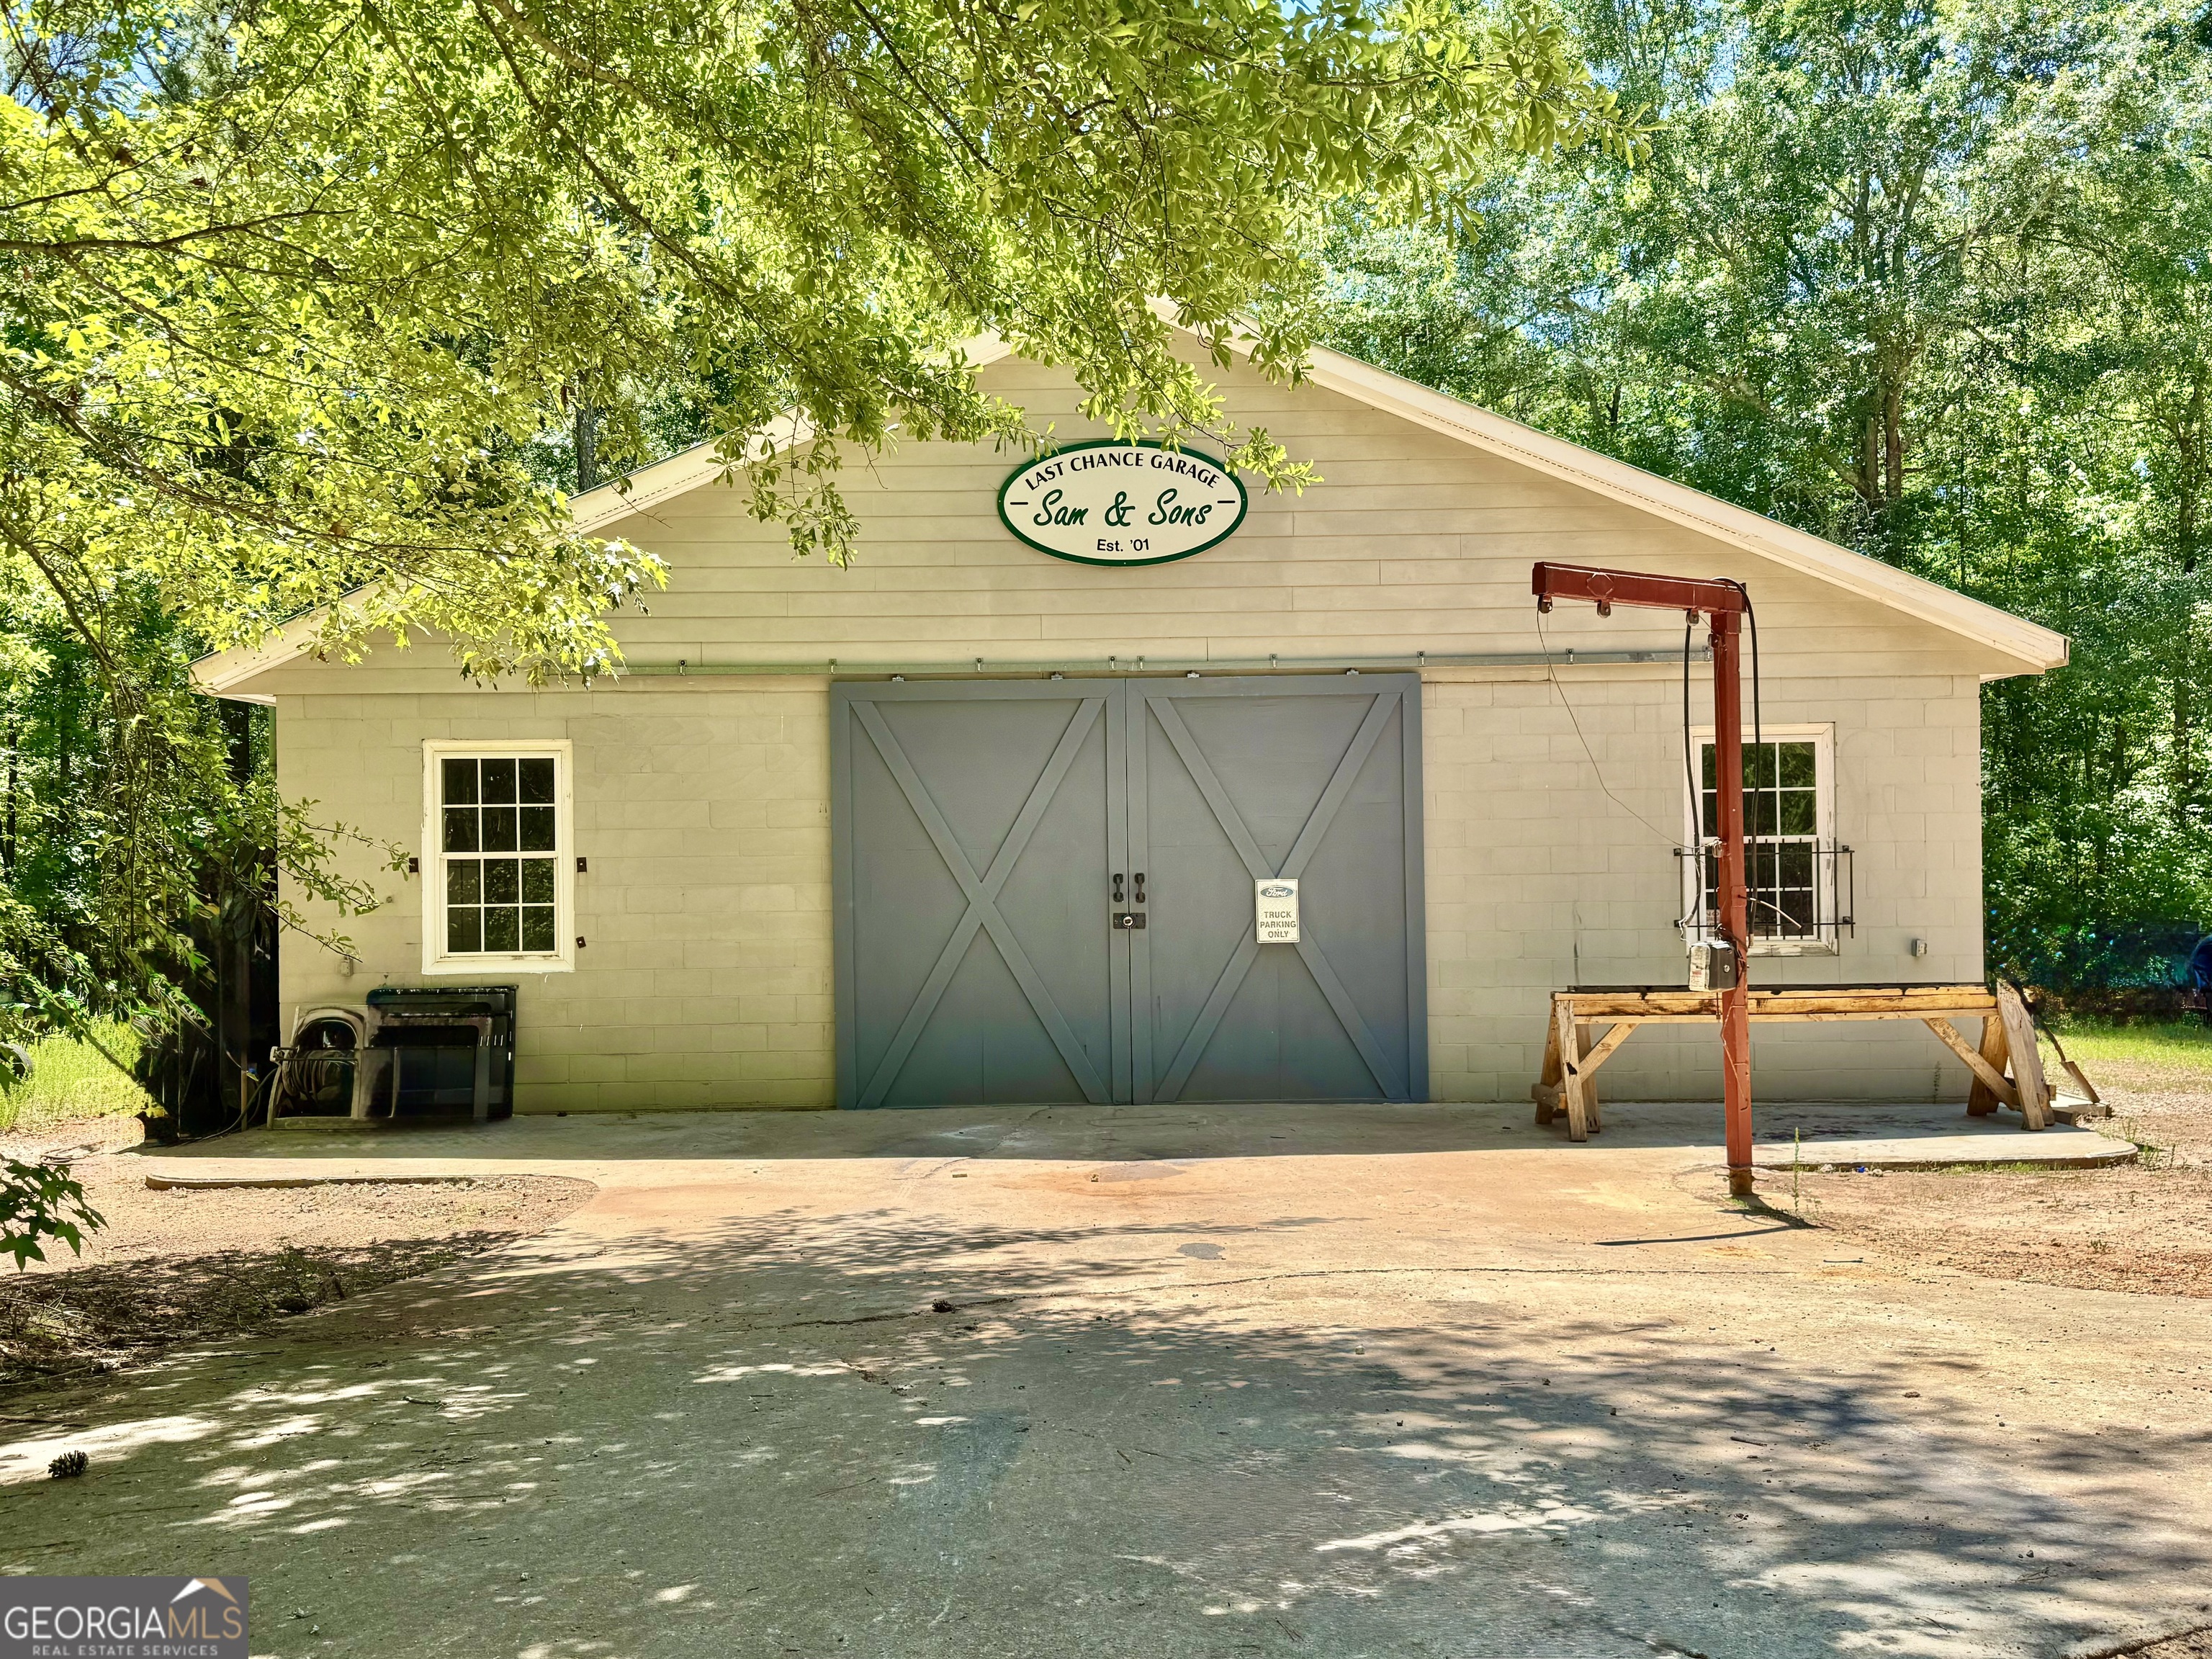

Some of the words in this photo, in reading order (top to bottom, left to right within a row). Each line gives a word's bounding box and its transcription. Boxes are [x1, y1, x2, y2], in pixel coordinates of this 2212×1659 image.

[1025, 462, 1064, 490] LAST
[1070, 452, 1143, 471] CHANCE
[1151, 454, 1220, 488] GARAGE
[1033, 489, 1089, 526] Sam
[1105, 491, 1136, 526] &
[1148, 488, 1212, 526] Sons
[1097, 539, 1123, 552] Est.
[1266, 887, 1288, 897] Ford
